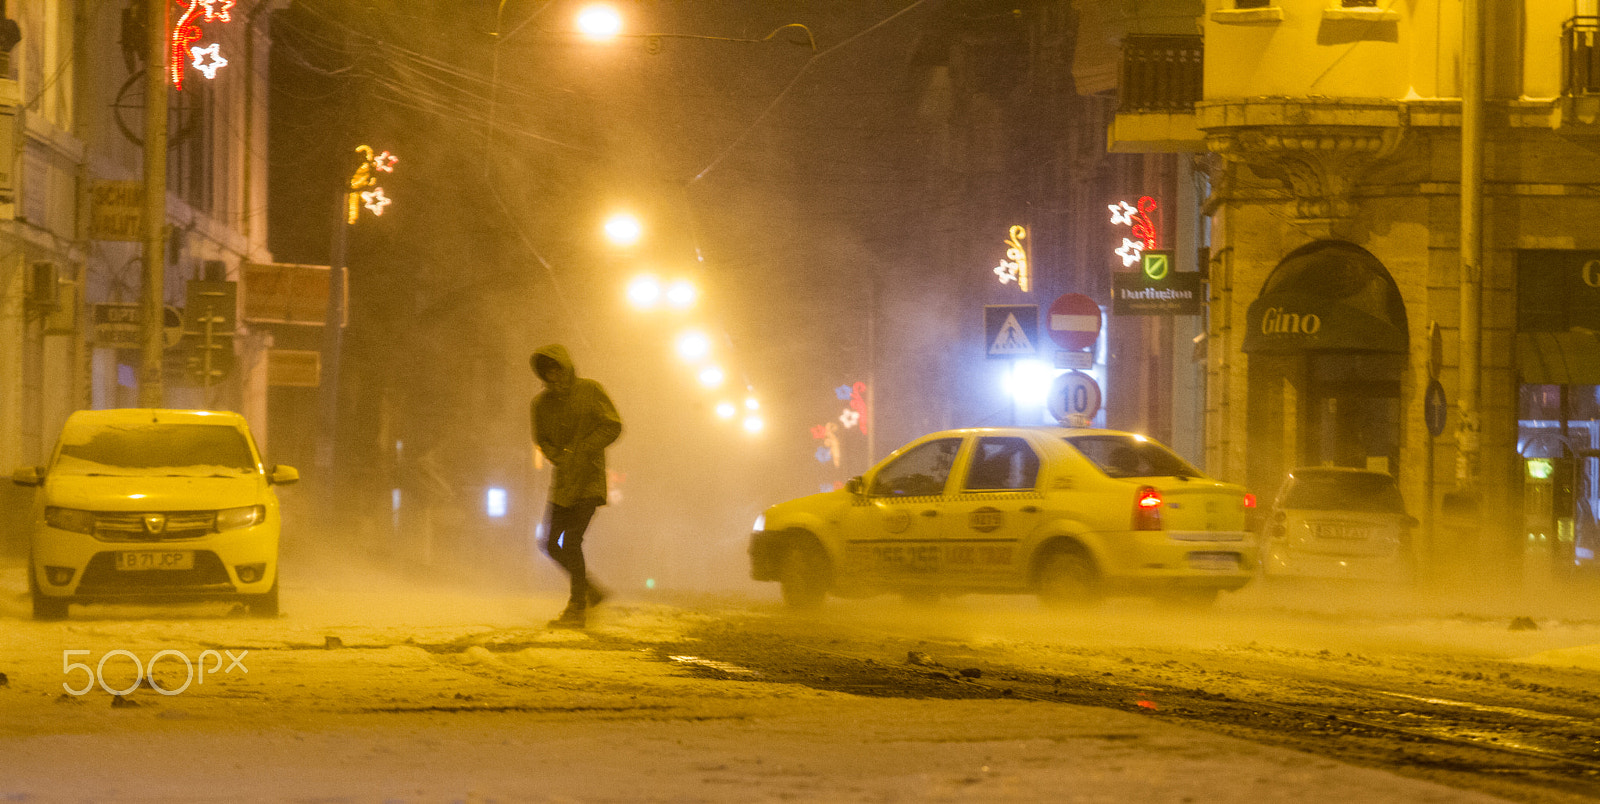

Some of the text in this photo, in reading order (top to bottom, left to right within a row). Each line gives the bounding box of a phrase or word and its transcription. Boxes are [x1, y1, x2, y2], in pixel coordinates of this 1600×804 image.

[1121, 286, 1193, 302] Darlington
[1261, 306, 1322, 336] Gino
[1060, 383, 1088, 414] 10
[127, 553, 137, 567] B
